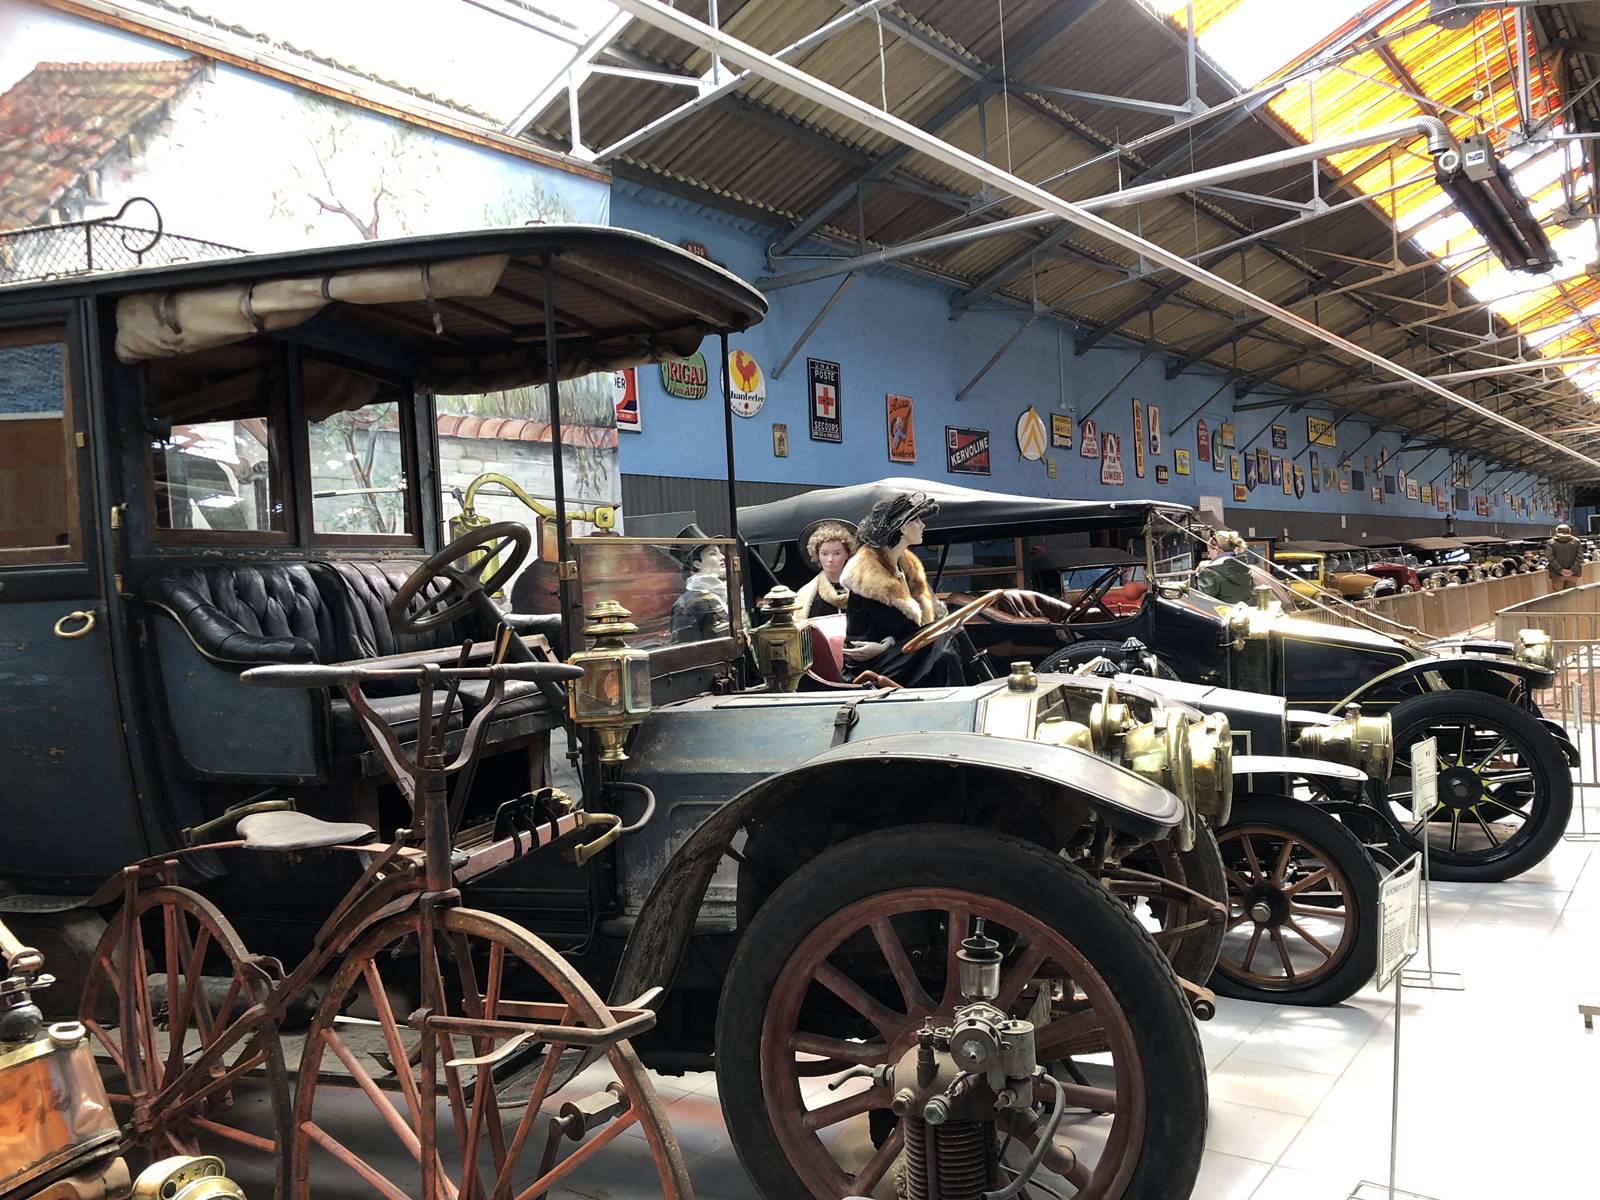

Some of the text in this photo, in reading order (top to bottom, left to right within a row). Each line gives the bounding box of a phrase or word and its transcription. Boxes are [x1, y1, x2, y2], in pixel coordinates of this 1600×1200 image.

[669, 361, 706, 386] RIGAL
[814, 369, 835, 382] POSTE
[814, 421, 839, 433] SECOURS
[950, 436, 989, 467] KERVOLINE
